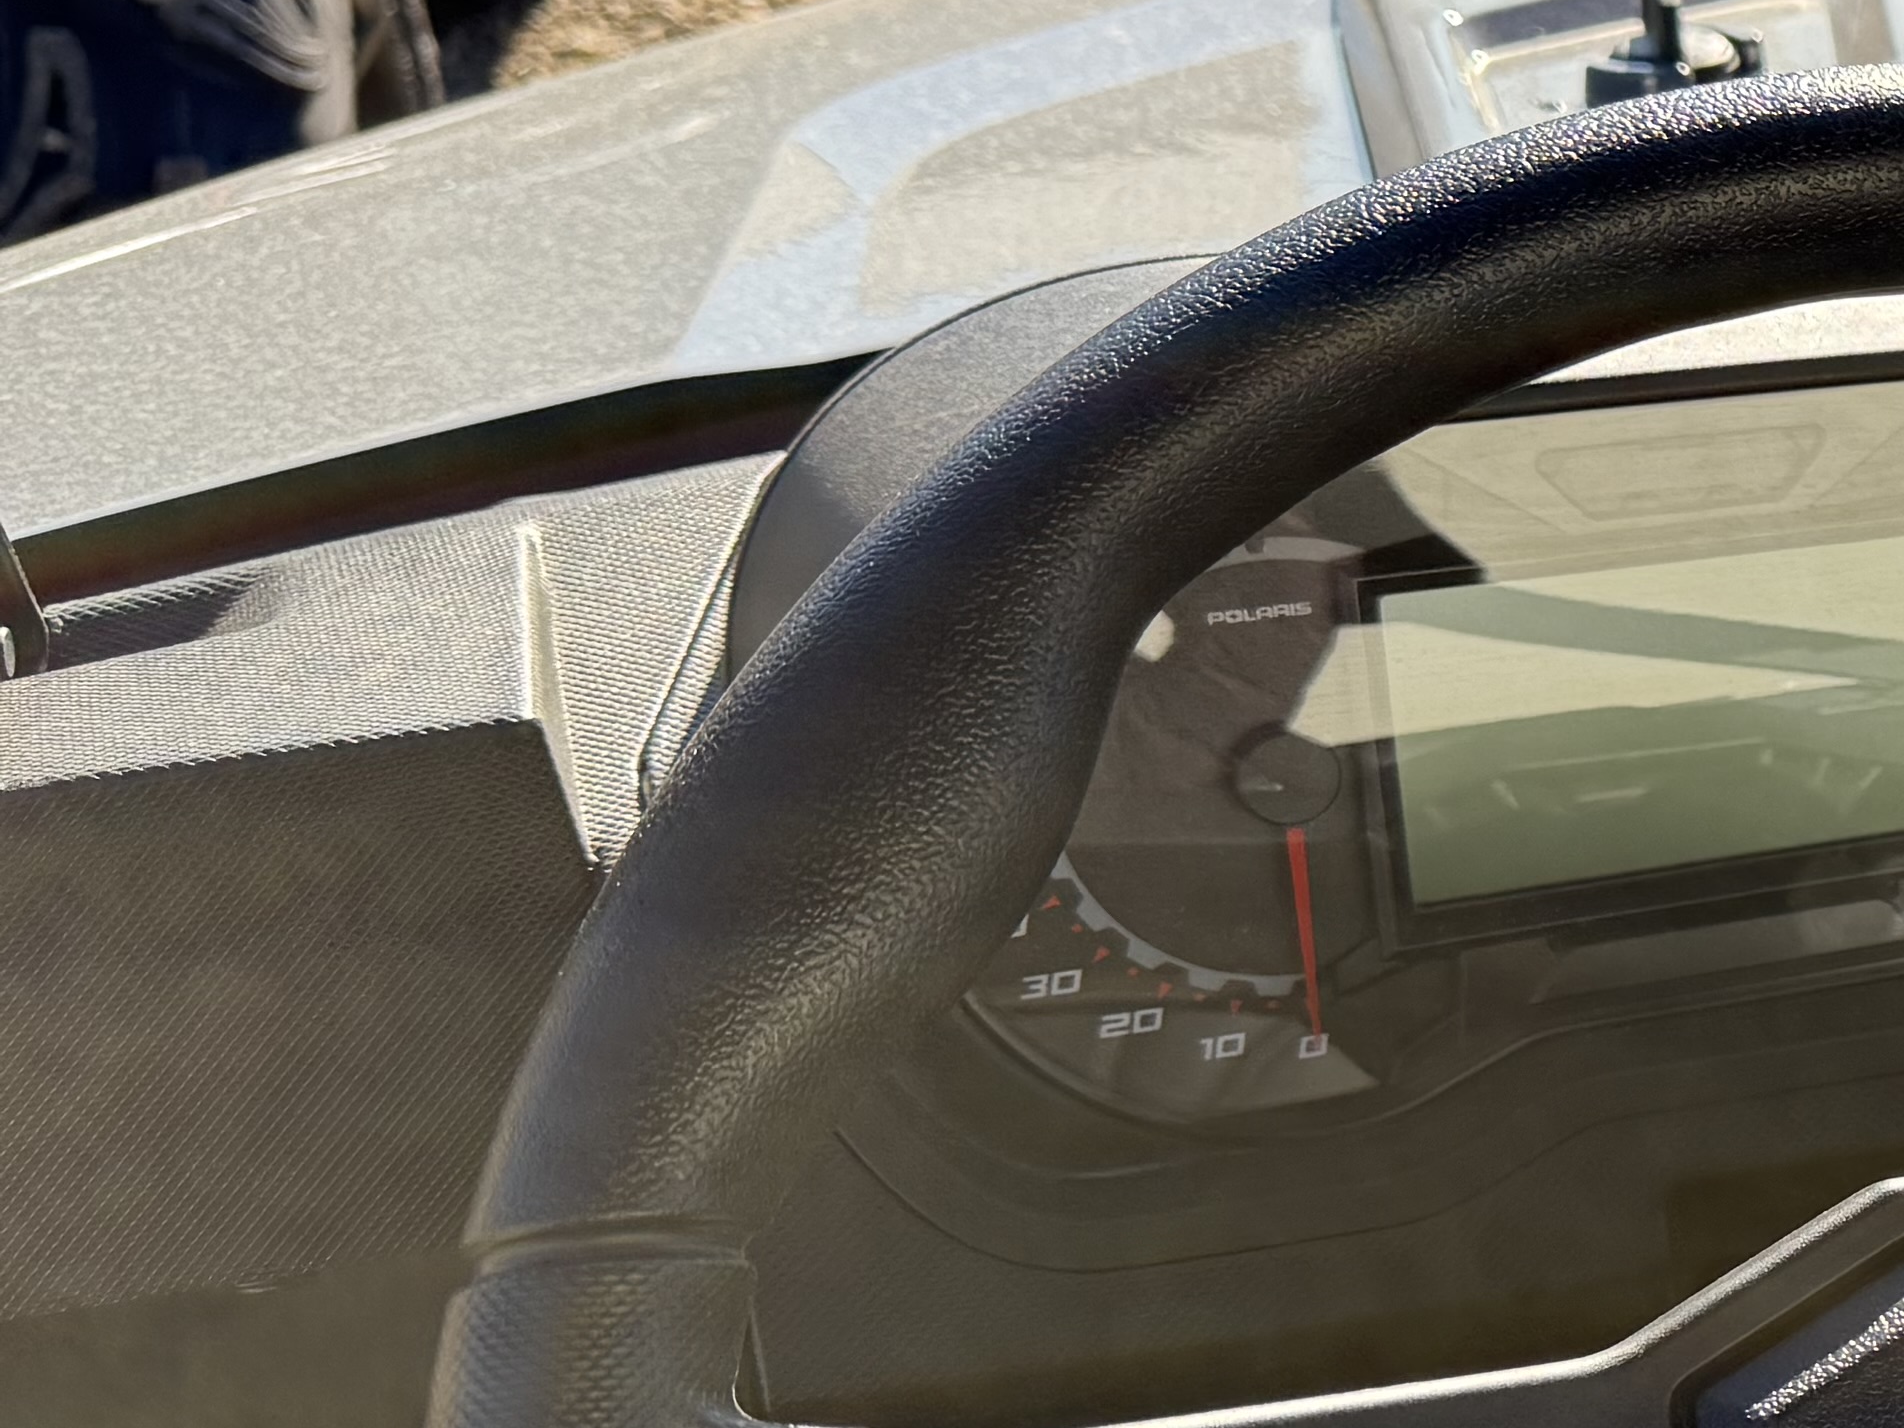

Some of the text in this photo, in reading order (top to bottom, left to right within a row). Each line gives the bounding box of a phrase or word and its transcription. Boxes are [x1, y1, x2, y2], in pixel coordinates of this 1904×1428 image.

[1207, 601, 1312, 625] POLARIS
[1020, 969, 1082, 1000] 30
[1100, 1007, 1163, 1038] 20
[1199, 1033, 1246, 1060] 10
[1299, 1033, 1328, 1059] 0
